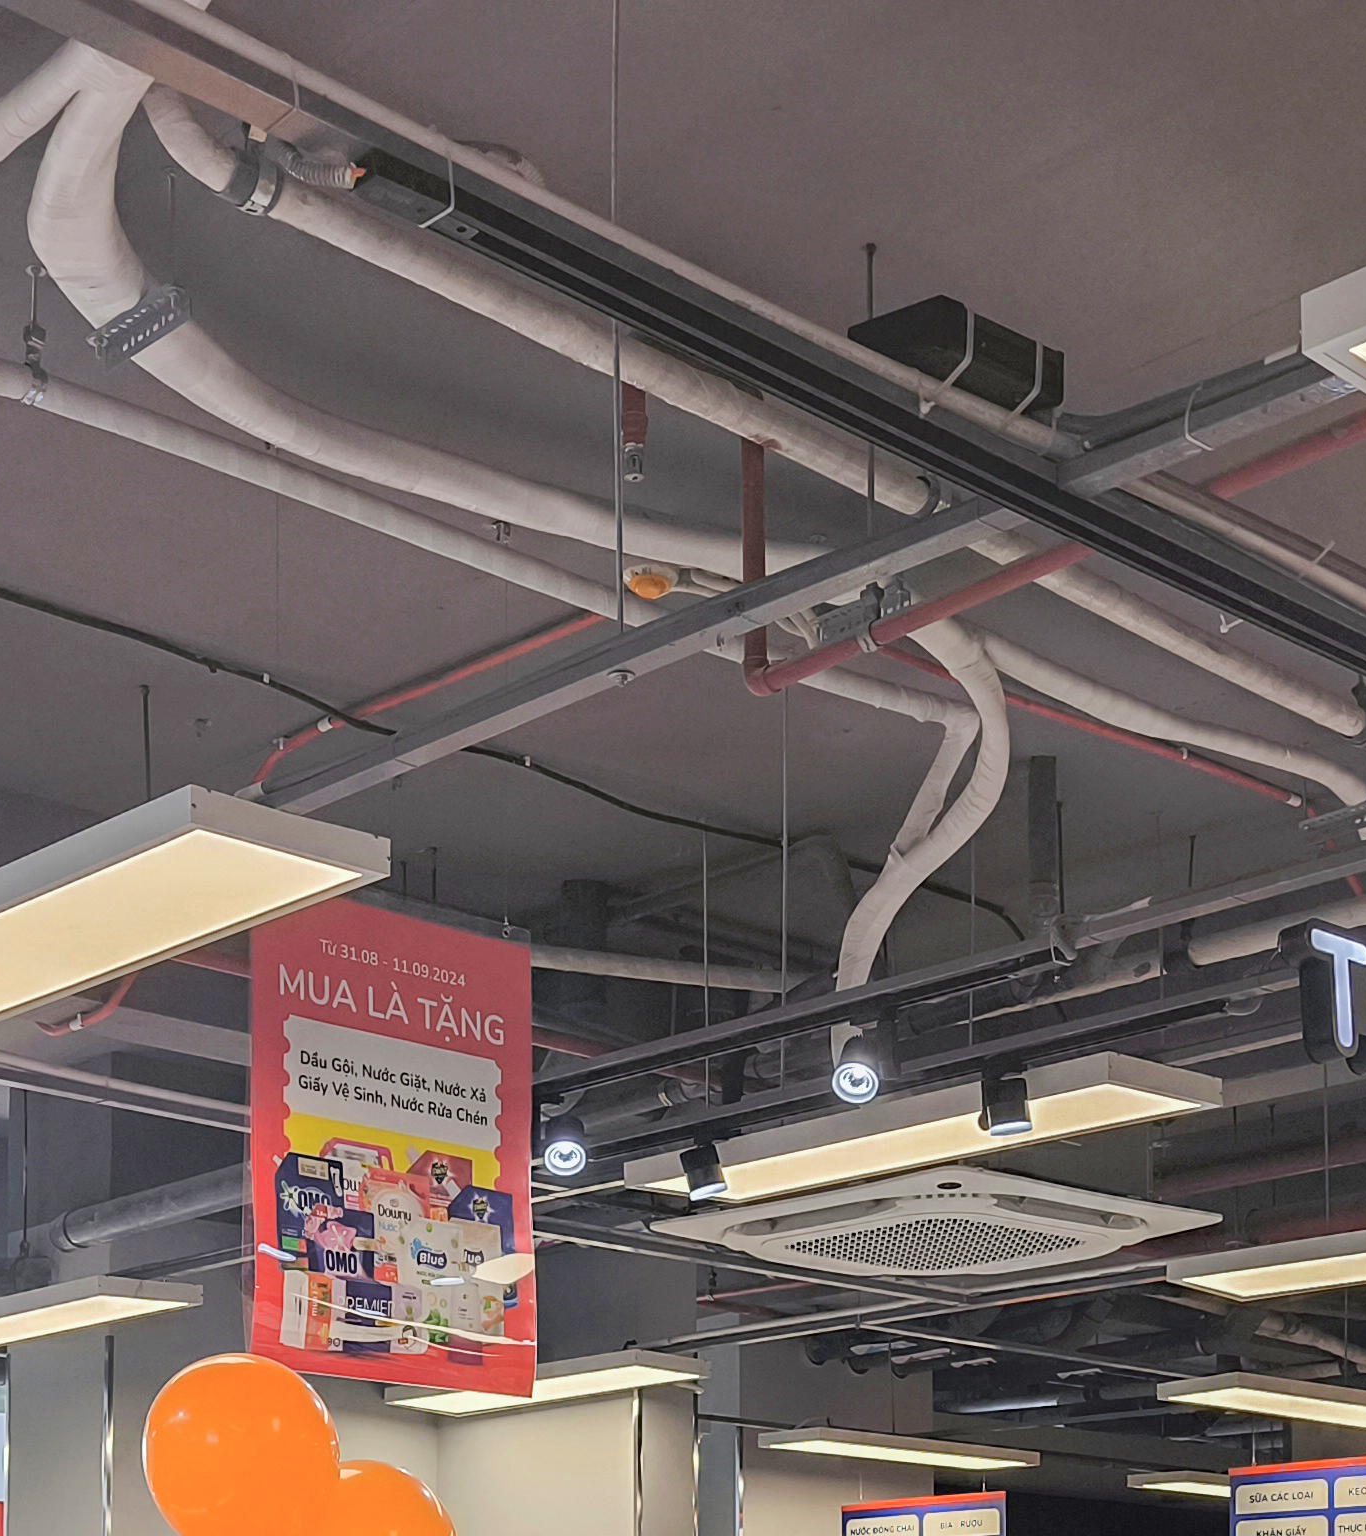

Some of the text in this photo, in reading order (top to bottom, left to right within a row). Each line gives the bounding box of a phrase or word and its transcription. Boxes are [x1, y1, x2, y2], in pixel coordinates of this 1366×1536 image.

[319, 939, 466, 987] Từ 31.08 11.09.2024
[279, 964, 504, 1045] MUA LÀ TẶNG
[300, 1050, 486, 1102] Dầu Gội, Nước Giặt, Nước Xả
[298, 1075, 487, 1126] Giấy Vệ Sinh, Nước Rửa Chén
[377, 1204, 411, 1222] Downy
[325, 1251, 357, 1274] OMO
[419, 1254, 446, 1266] Blue
[1249, 1491, 1288, 1503] SỮA CÁC
[850, 1527, 871, 1536] NƯỚC
[1285, 1526, 1306, 1536] GIẤY
